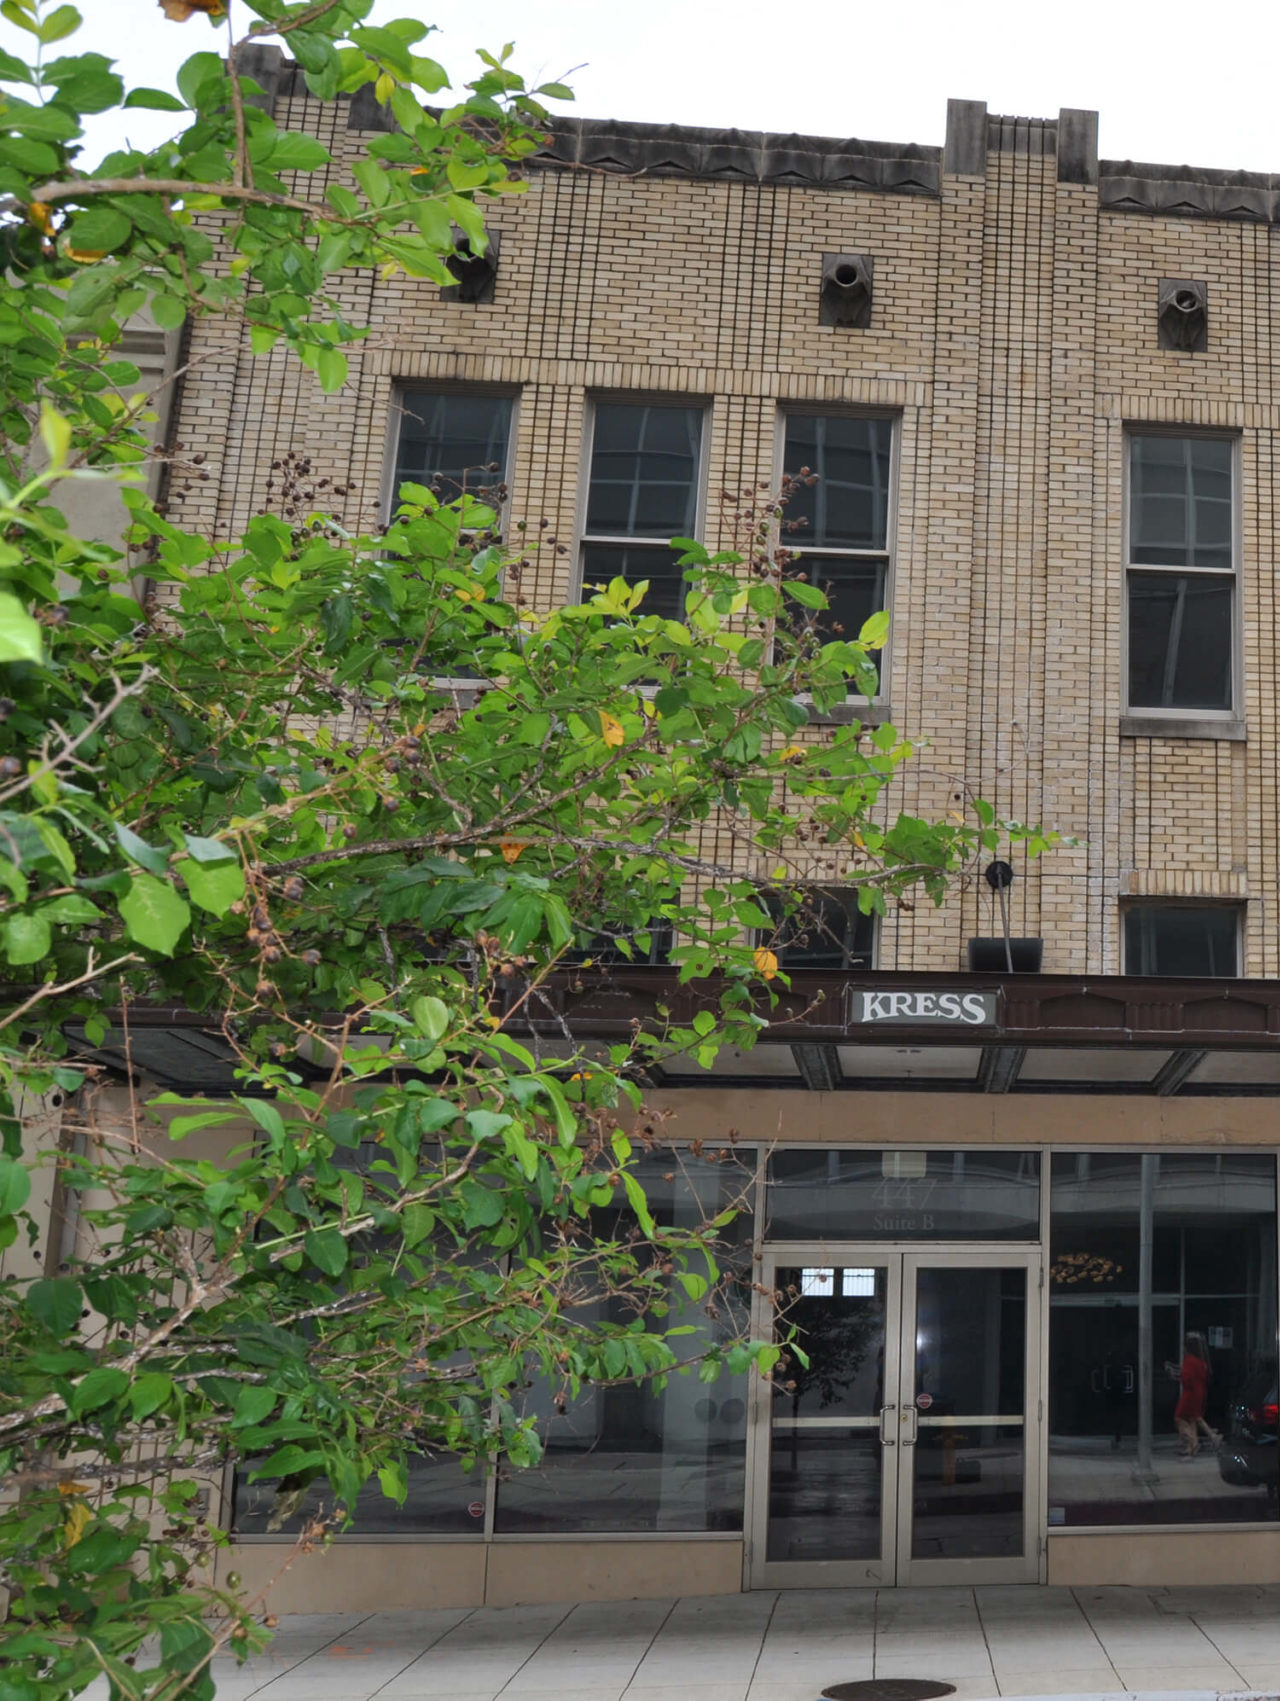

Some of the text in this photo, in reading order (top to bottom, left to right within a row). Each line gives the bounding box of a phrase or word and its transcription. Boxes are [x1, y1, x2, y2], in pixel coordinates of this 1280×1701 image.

[862, 992, 986, 1025] KRESS
[872, 1177, 938, 1210] 447
[873, 1214, 936, 1231] Suite B
